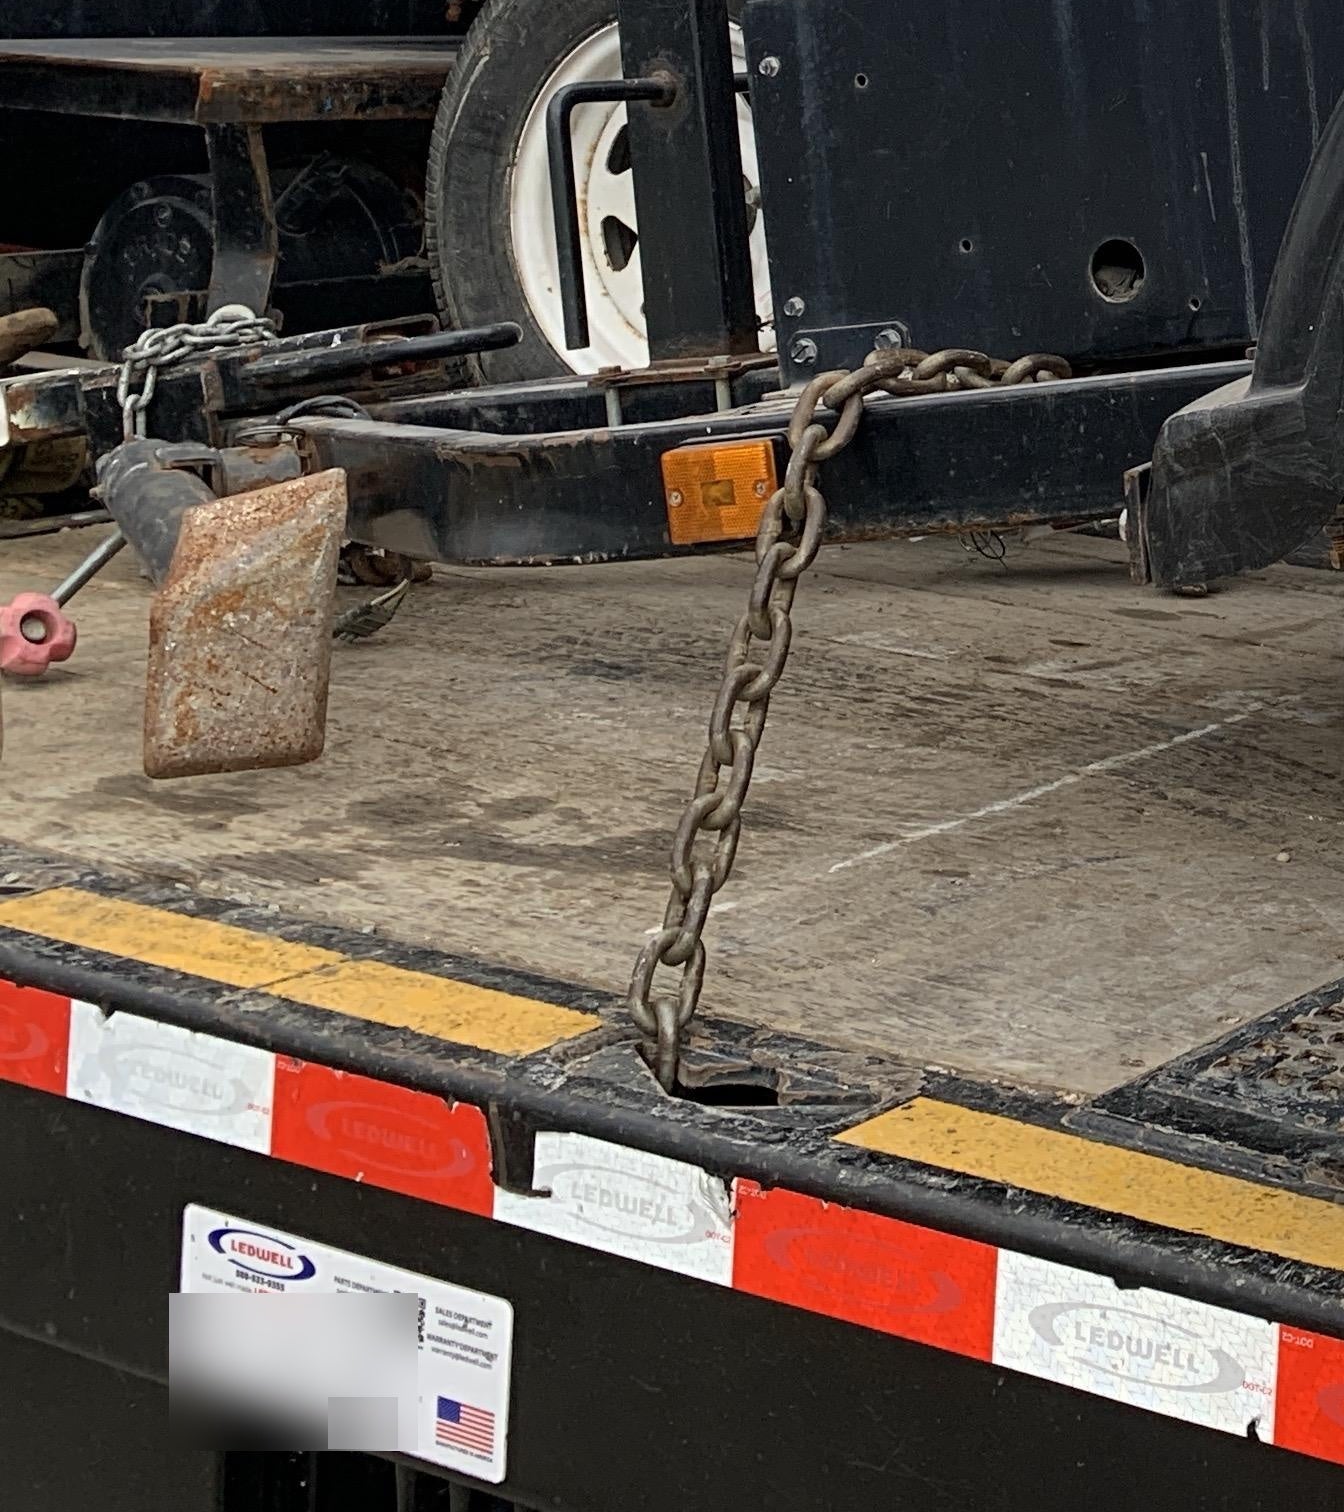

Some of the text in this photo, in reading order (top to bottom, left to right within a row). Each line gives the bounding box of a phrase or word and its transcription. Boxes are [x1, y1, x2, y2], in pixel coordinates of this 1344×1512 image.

[571, 1180, 679, 1226] LEDWELL
[230, 1239, 294, 1269] LEDWELL
[435, 1306, 493, 1329] SALES DEPARTMENT
[427, 1333, 459, 1350] WARRANTY
[1075, 1321, 1200, 1374] LEDWELL
[1242, 1380, 1273, 1396] DOT-C2
